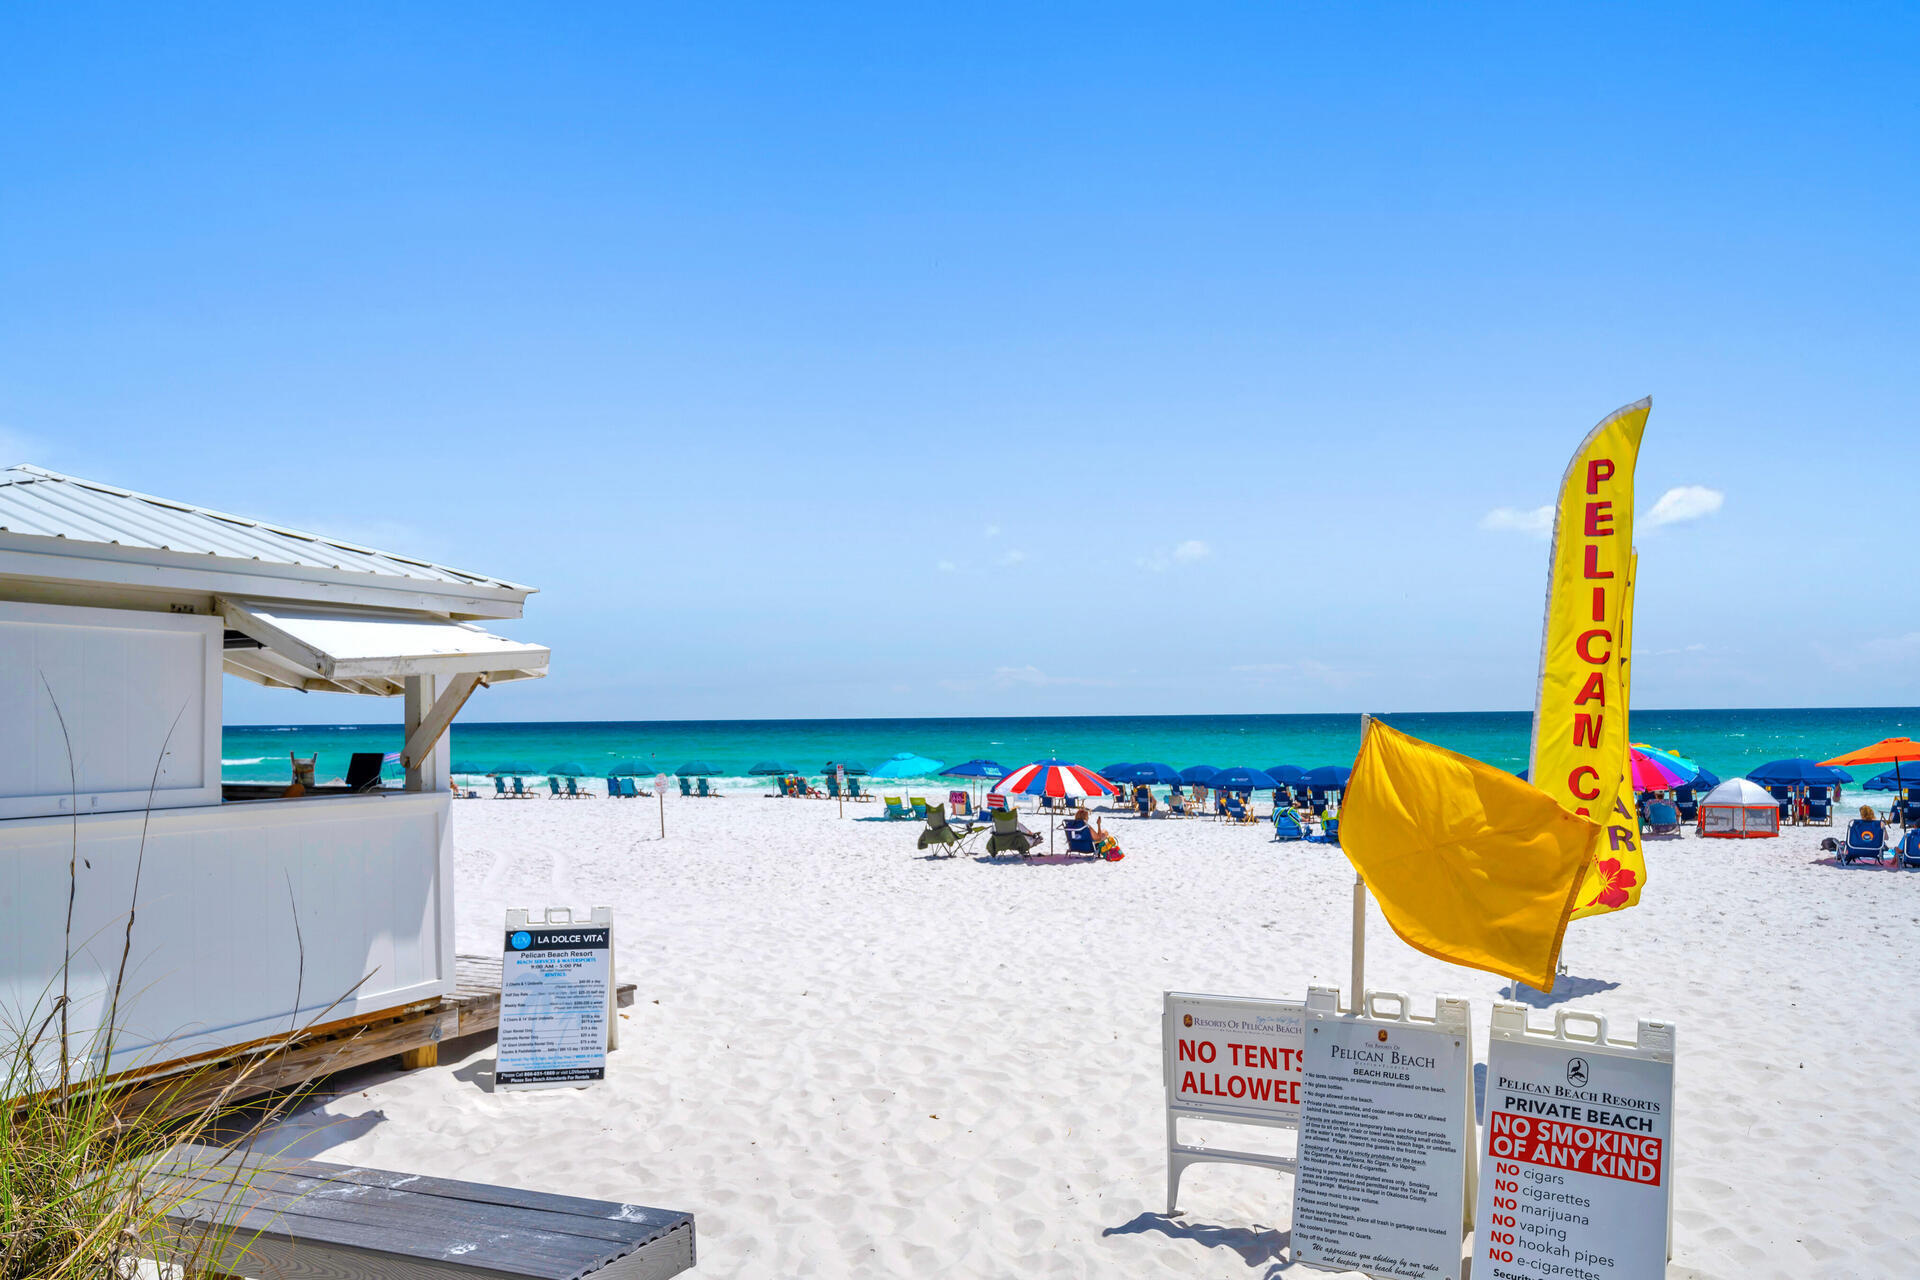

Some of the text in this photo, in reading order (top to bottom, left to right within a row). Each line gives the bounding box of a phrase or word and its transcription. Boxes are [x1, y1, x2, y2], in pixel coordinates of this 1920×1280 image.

[1568, 459, 1615, 817] PELICAN C
[1194, 1017, 1226, 1028] RESORTS
[1242, 1021, 1274, 1032] PELICAN
[1276, 1024, 1302, 1034] BEACH
[1179, 1039, 1216, 1063] NO
[1331, 1045, 1384, 1063] PELICAN
[1391, 1051, 1435, 1068] BEACH
[1353, 1068, 1410, 1081] BEACH RULES
[1499, 1077, 1660, 1111] PELICAN BEACH RESORTS
[1505, 1096, 1653, 1133] PRIVATE BEACH
[1493, 1115, 1658, 1161] NO SMOKING
[1493, 1137, 1656, 1182] OF ANY KIND
[1496, 1162, 1564, 1186] NO cigars
[1495, 1179, 1590, 1208] NO cigarettes
[1315, 1209, 1331, 1217] leaving
[1428, 1227, 1446, 1235] located
[1493, 1196, 1589, 1226] NO marijuana
[1298, 1232, 1308, 1240] Stay
[1492, 1213, 1567, 1242] NO vaping
[1312, 1242, 1322, 1251] We
[1324, 1247, 1357, 1257] appreciate
[1372, 1254, 1397, 1266] abiding
[1398, 1257, 1407, 1268] by
[1422, 1263, 1438, 1271] rules
[1489, 1248, 1600, 1280] NO e-cigarettes
[1490, 1231, 1614, 1268] NO hookah pipes
[1336, 1256, 1360, 1269] keeping
[1374, 1263, 1393, 1272] beach
[1394, 1266, 1425, 1279] beautiful.
